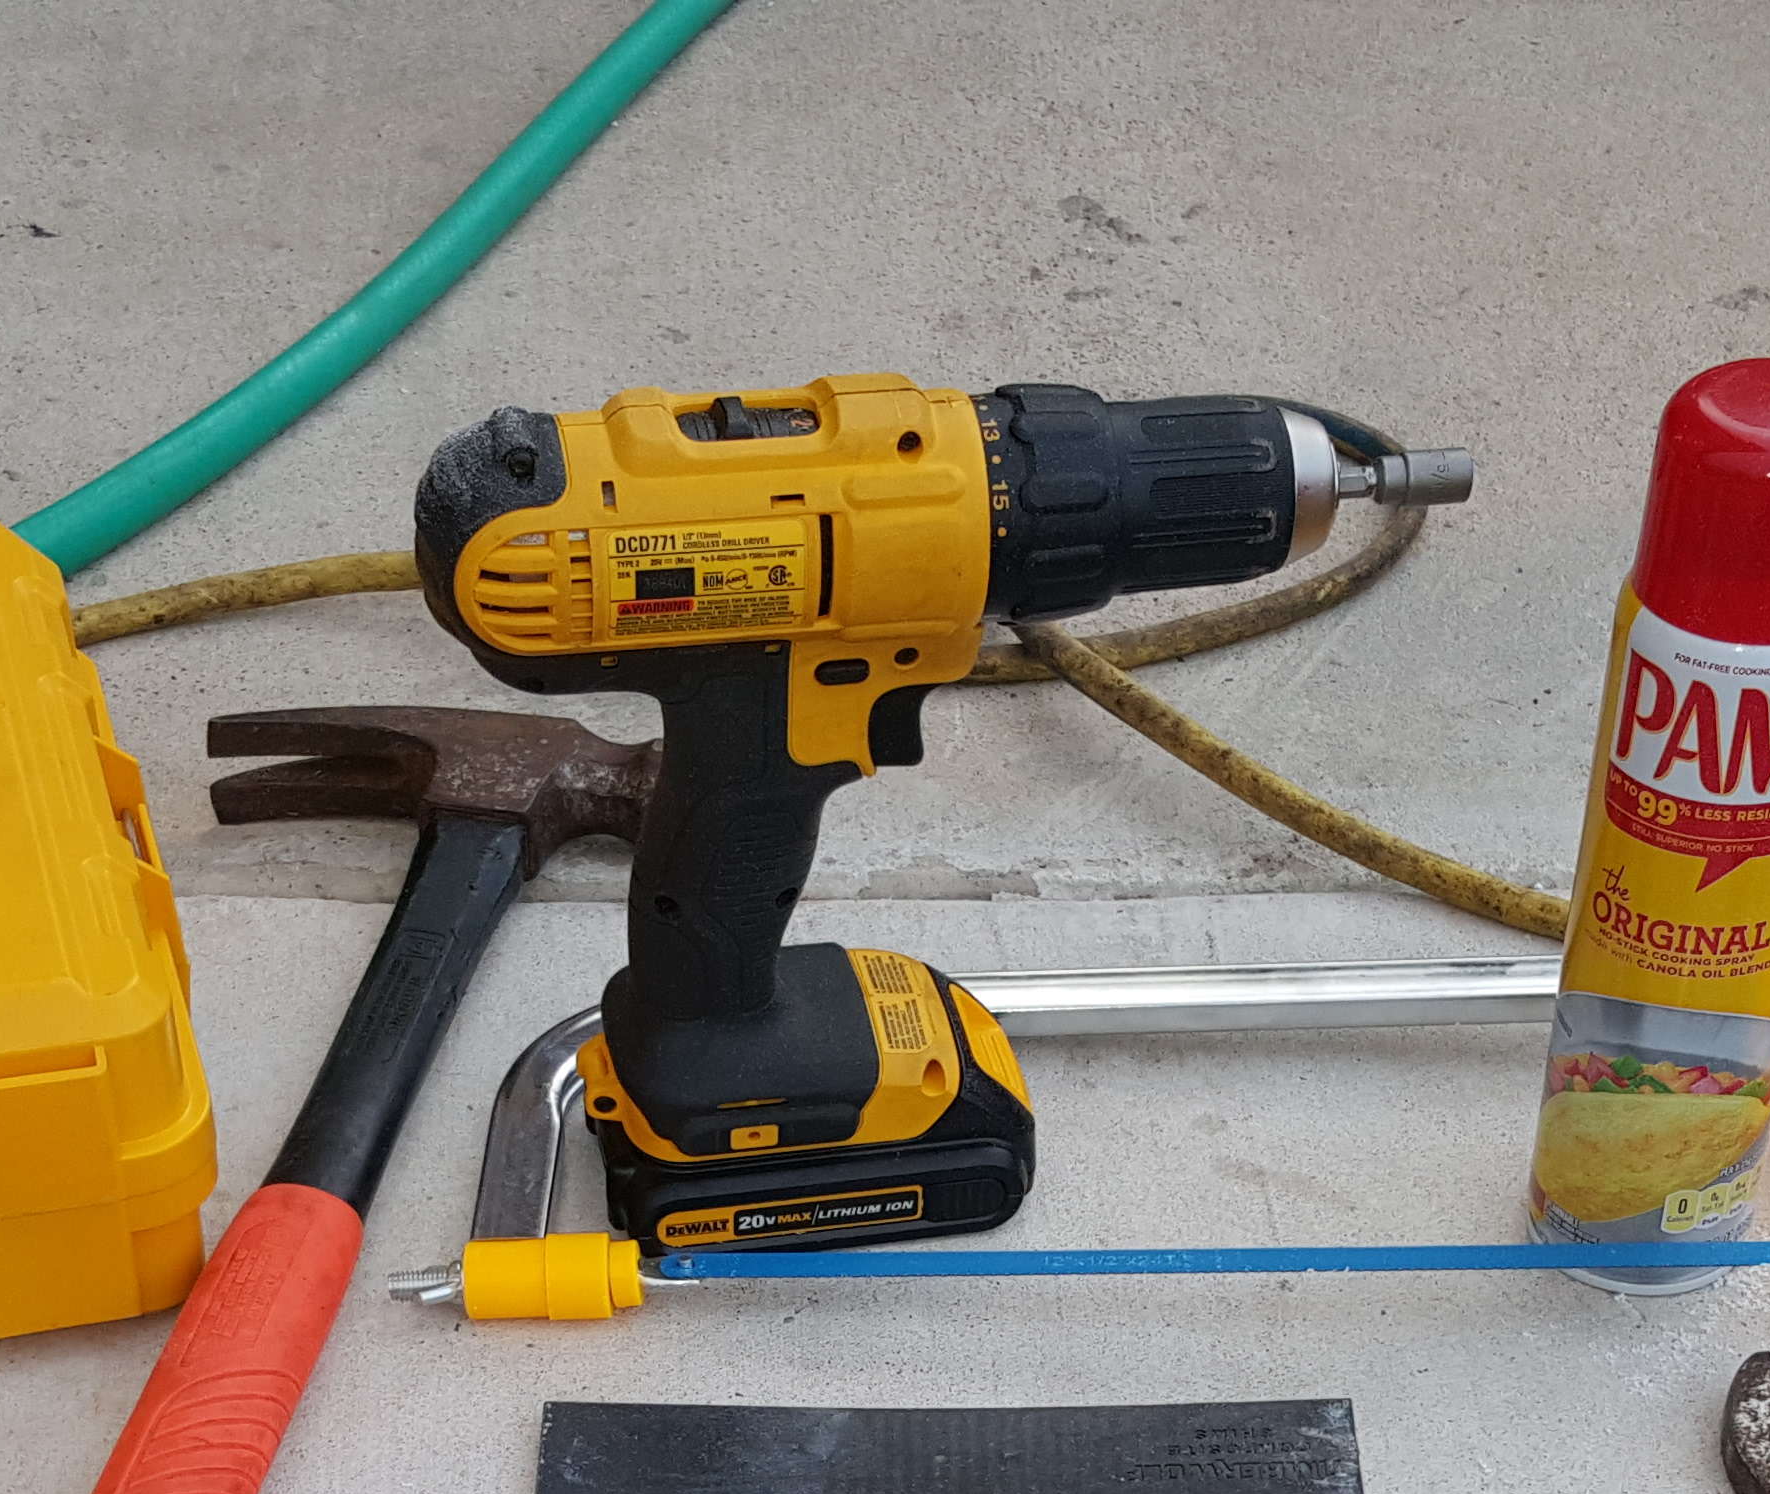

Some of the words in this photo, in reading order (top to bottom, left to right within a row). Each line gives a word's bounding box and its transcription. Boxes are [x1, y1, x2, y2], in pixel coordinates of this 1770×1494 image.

[991, 479, 1011, 512] 15
[616, 535, 676, 553] DCD771
[1674, 652, 1691, 664] FOR
[1691, 659, 1731, 674] FAT-FREE
[1609, 771, 1622, 786] UP
[1623, 779, 1638, 796] TO
[1695, 808, 1731, 822] LESS
[1655, 834, 1704, 852] SUPERIOR
[1706, 843, 1722, 852] NO
[1725, 843, 1754, 853] STICK
[1602, 865, 1630, 901] the
[1592, 891, 1770, 956] ORIGINAL
[1637, 958, 1697, 979] CANOLA
[1701, 968, 1726, 979] OIL
[1652, 951, 1712, 967] COOKING
[1715, 953, 1756, 967] SPRAY
[885, 1200, 914, 1212] ION
